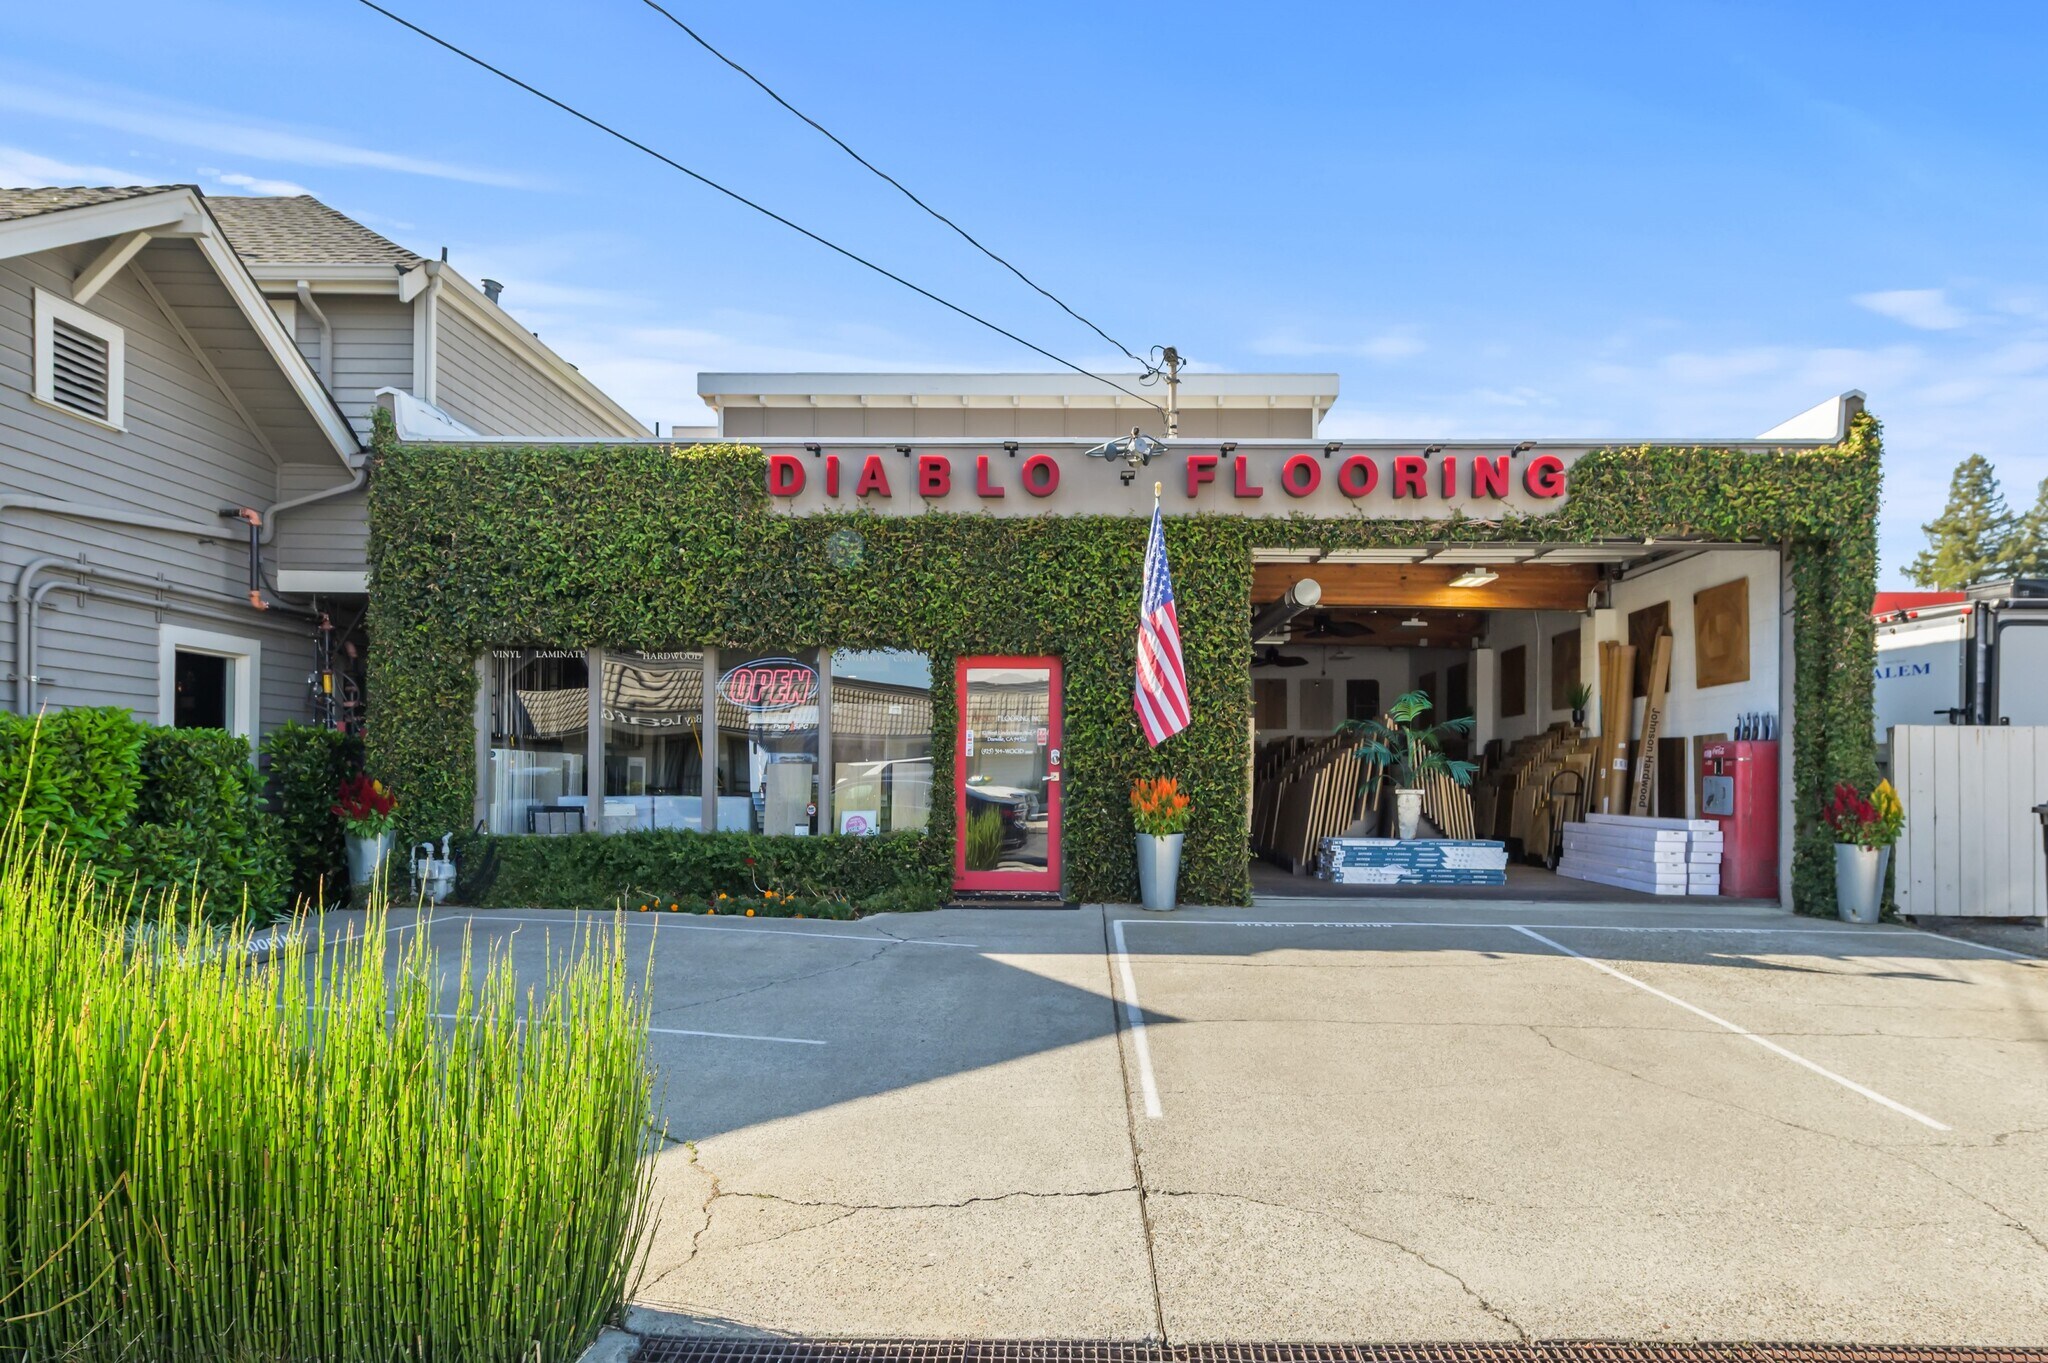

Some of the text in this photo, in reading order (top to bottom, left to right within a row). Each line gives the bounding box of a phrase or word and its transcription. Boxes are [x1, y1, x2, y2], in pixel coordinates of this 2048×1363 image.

[769, 454, 1566, 499] DIABLO FLOORING
[492, 650, 586, 658] VINYL LAMINATE
[642, 652, 703, 660] HARDWOOD
[1874, 663, 1931, 679] ALEM
[730, 668, 811, 703] OPEN
